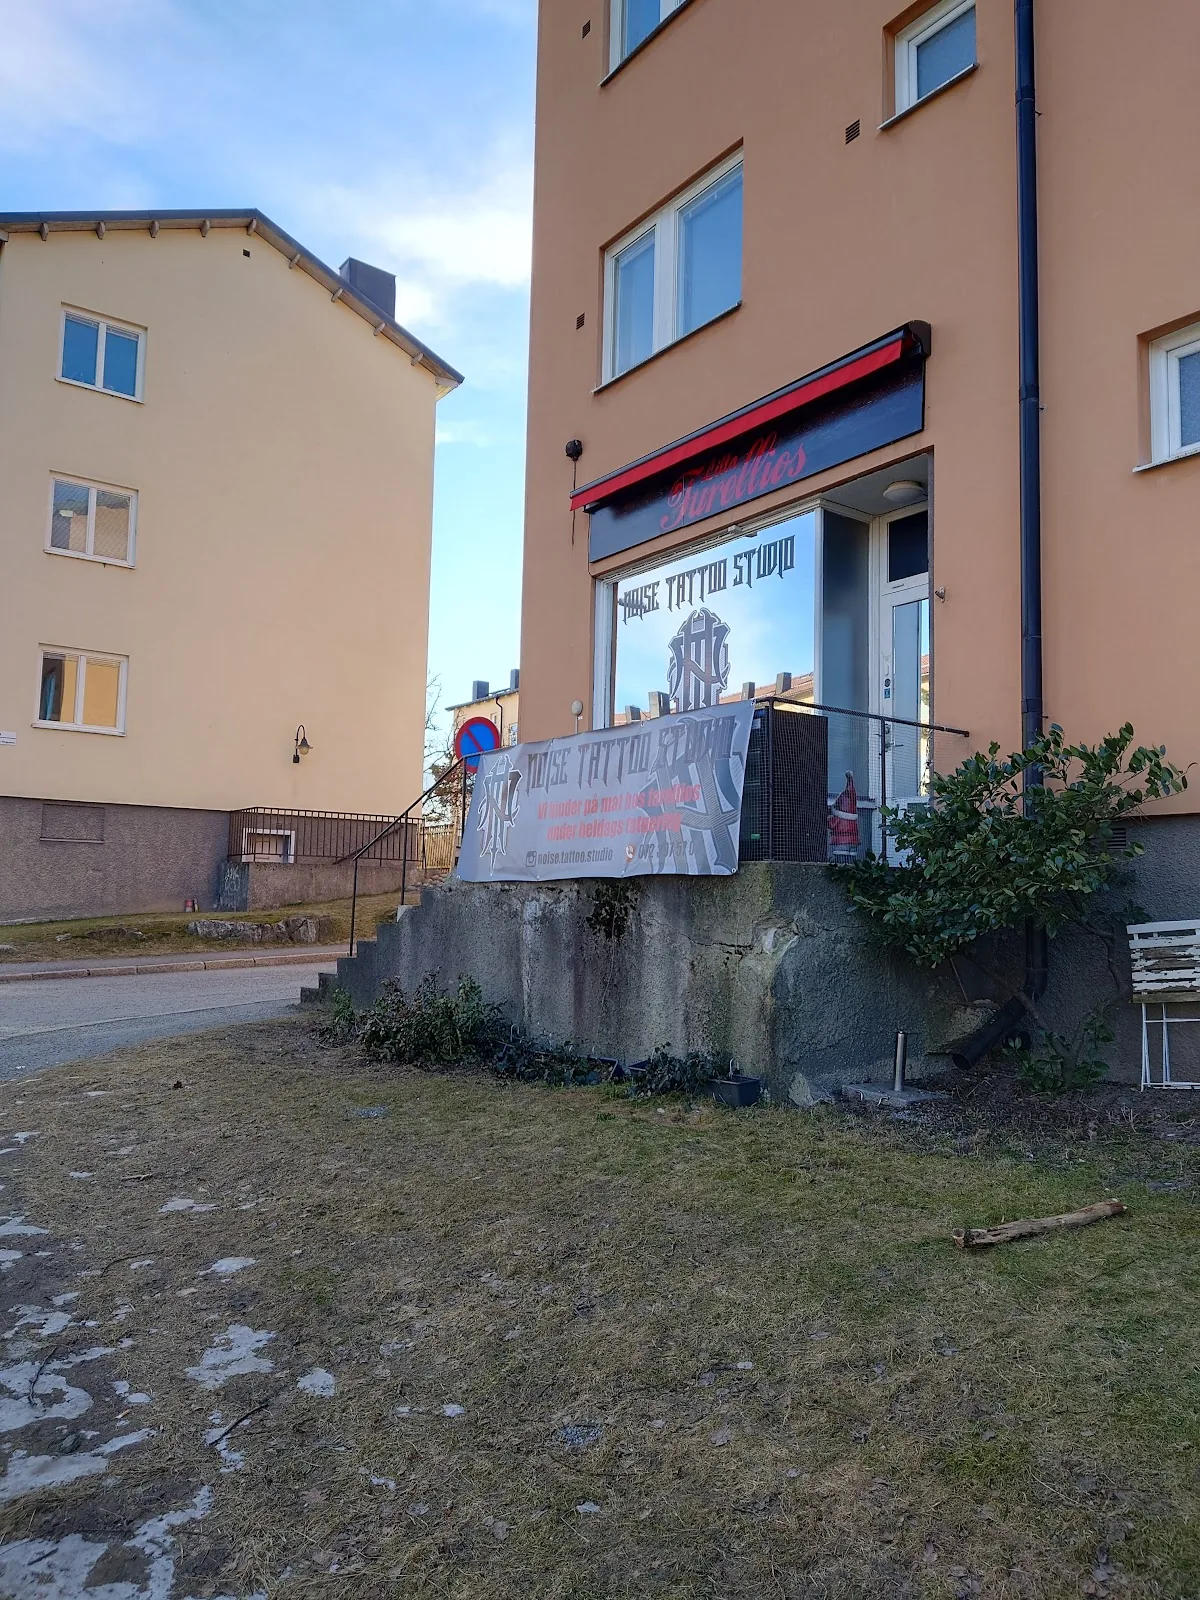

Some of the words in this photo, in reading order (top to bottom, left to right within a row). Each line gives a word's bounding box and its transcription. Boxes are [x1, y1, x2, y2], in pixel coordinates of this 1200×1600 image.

[623, 580, 660, 625] NOISE
[665, 558, 728, 612] TATTOO
[733, 535, 795, 588] STUDIO
[525, 747, 572, 797] NOISE
[577, 732, 652, 790] TATTOO
[584, 793, 599, 816] på
[601, 794, 624, 813] mat
[546, 822, 577, 840] under
[578, 818, 624, 838] heldags
[537, 847, 614, 865] noise.tattoo.studio
